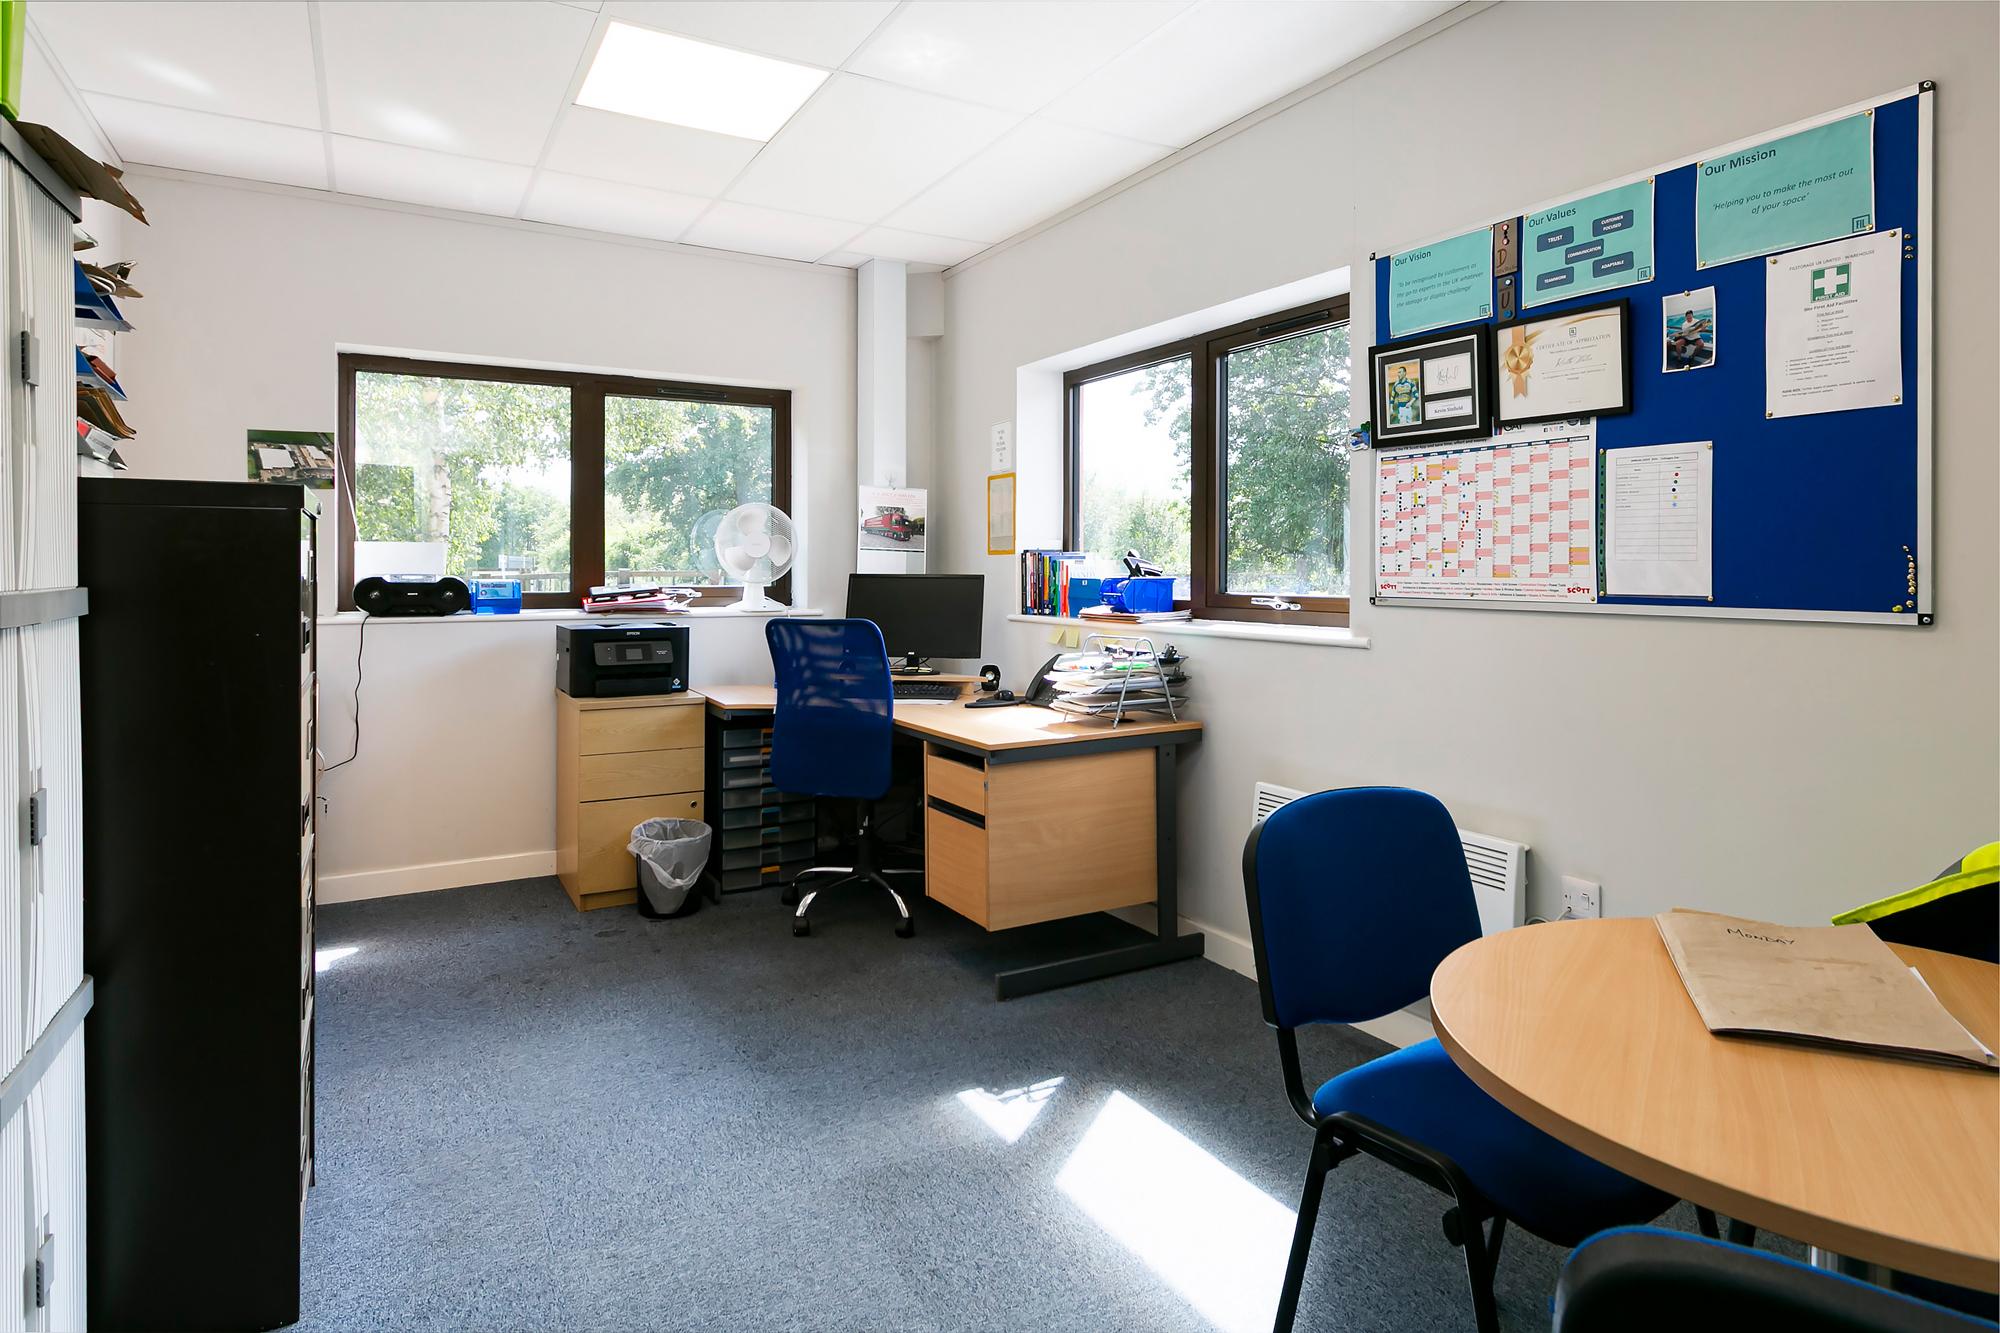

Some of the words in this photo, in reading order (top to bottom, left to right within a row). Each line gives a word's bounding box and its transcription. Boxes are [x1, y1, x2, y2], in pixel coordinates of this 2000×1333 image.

[1705, 163, 1727, 177] Our
[1729, 149, 1777, 170] Mission
[1746, 193, 1761, 204] you
[1763, 190, 1772, 198] to
[1773, 183, 1797, 196] make
[1798, 178, 1812, 188] the
[1815, 173, 1836, 184] most
[1838, 167, 1854, 178] out
[1751, 205, 1760, 215] of
[1762, 201, 1781, 213] your
[1529, 217, 1544, 228] Our
[1546, 207, 1577, 223] Values
[1547, 234, 1563, 243] TRUST
[1394, 257, 1407, 267] Our
[1409, 250, 1432, 262] Vision
[1567, 246, 1602, 259] COMMUNICATION
[1567, 586, 1590, 594] SCOTT
